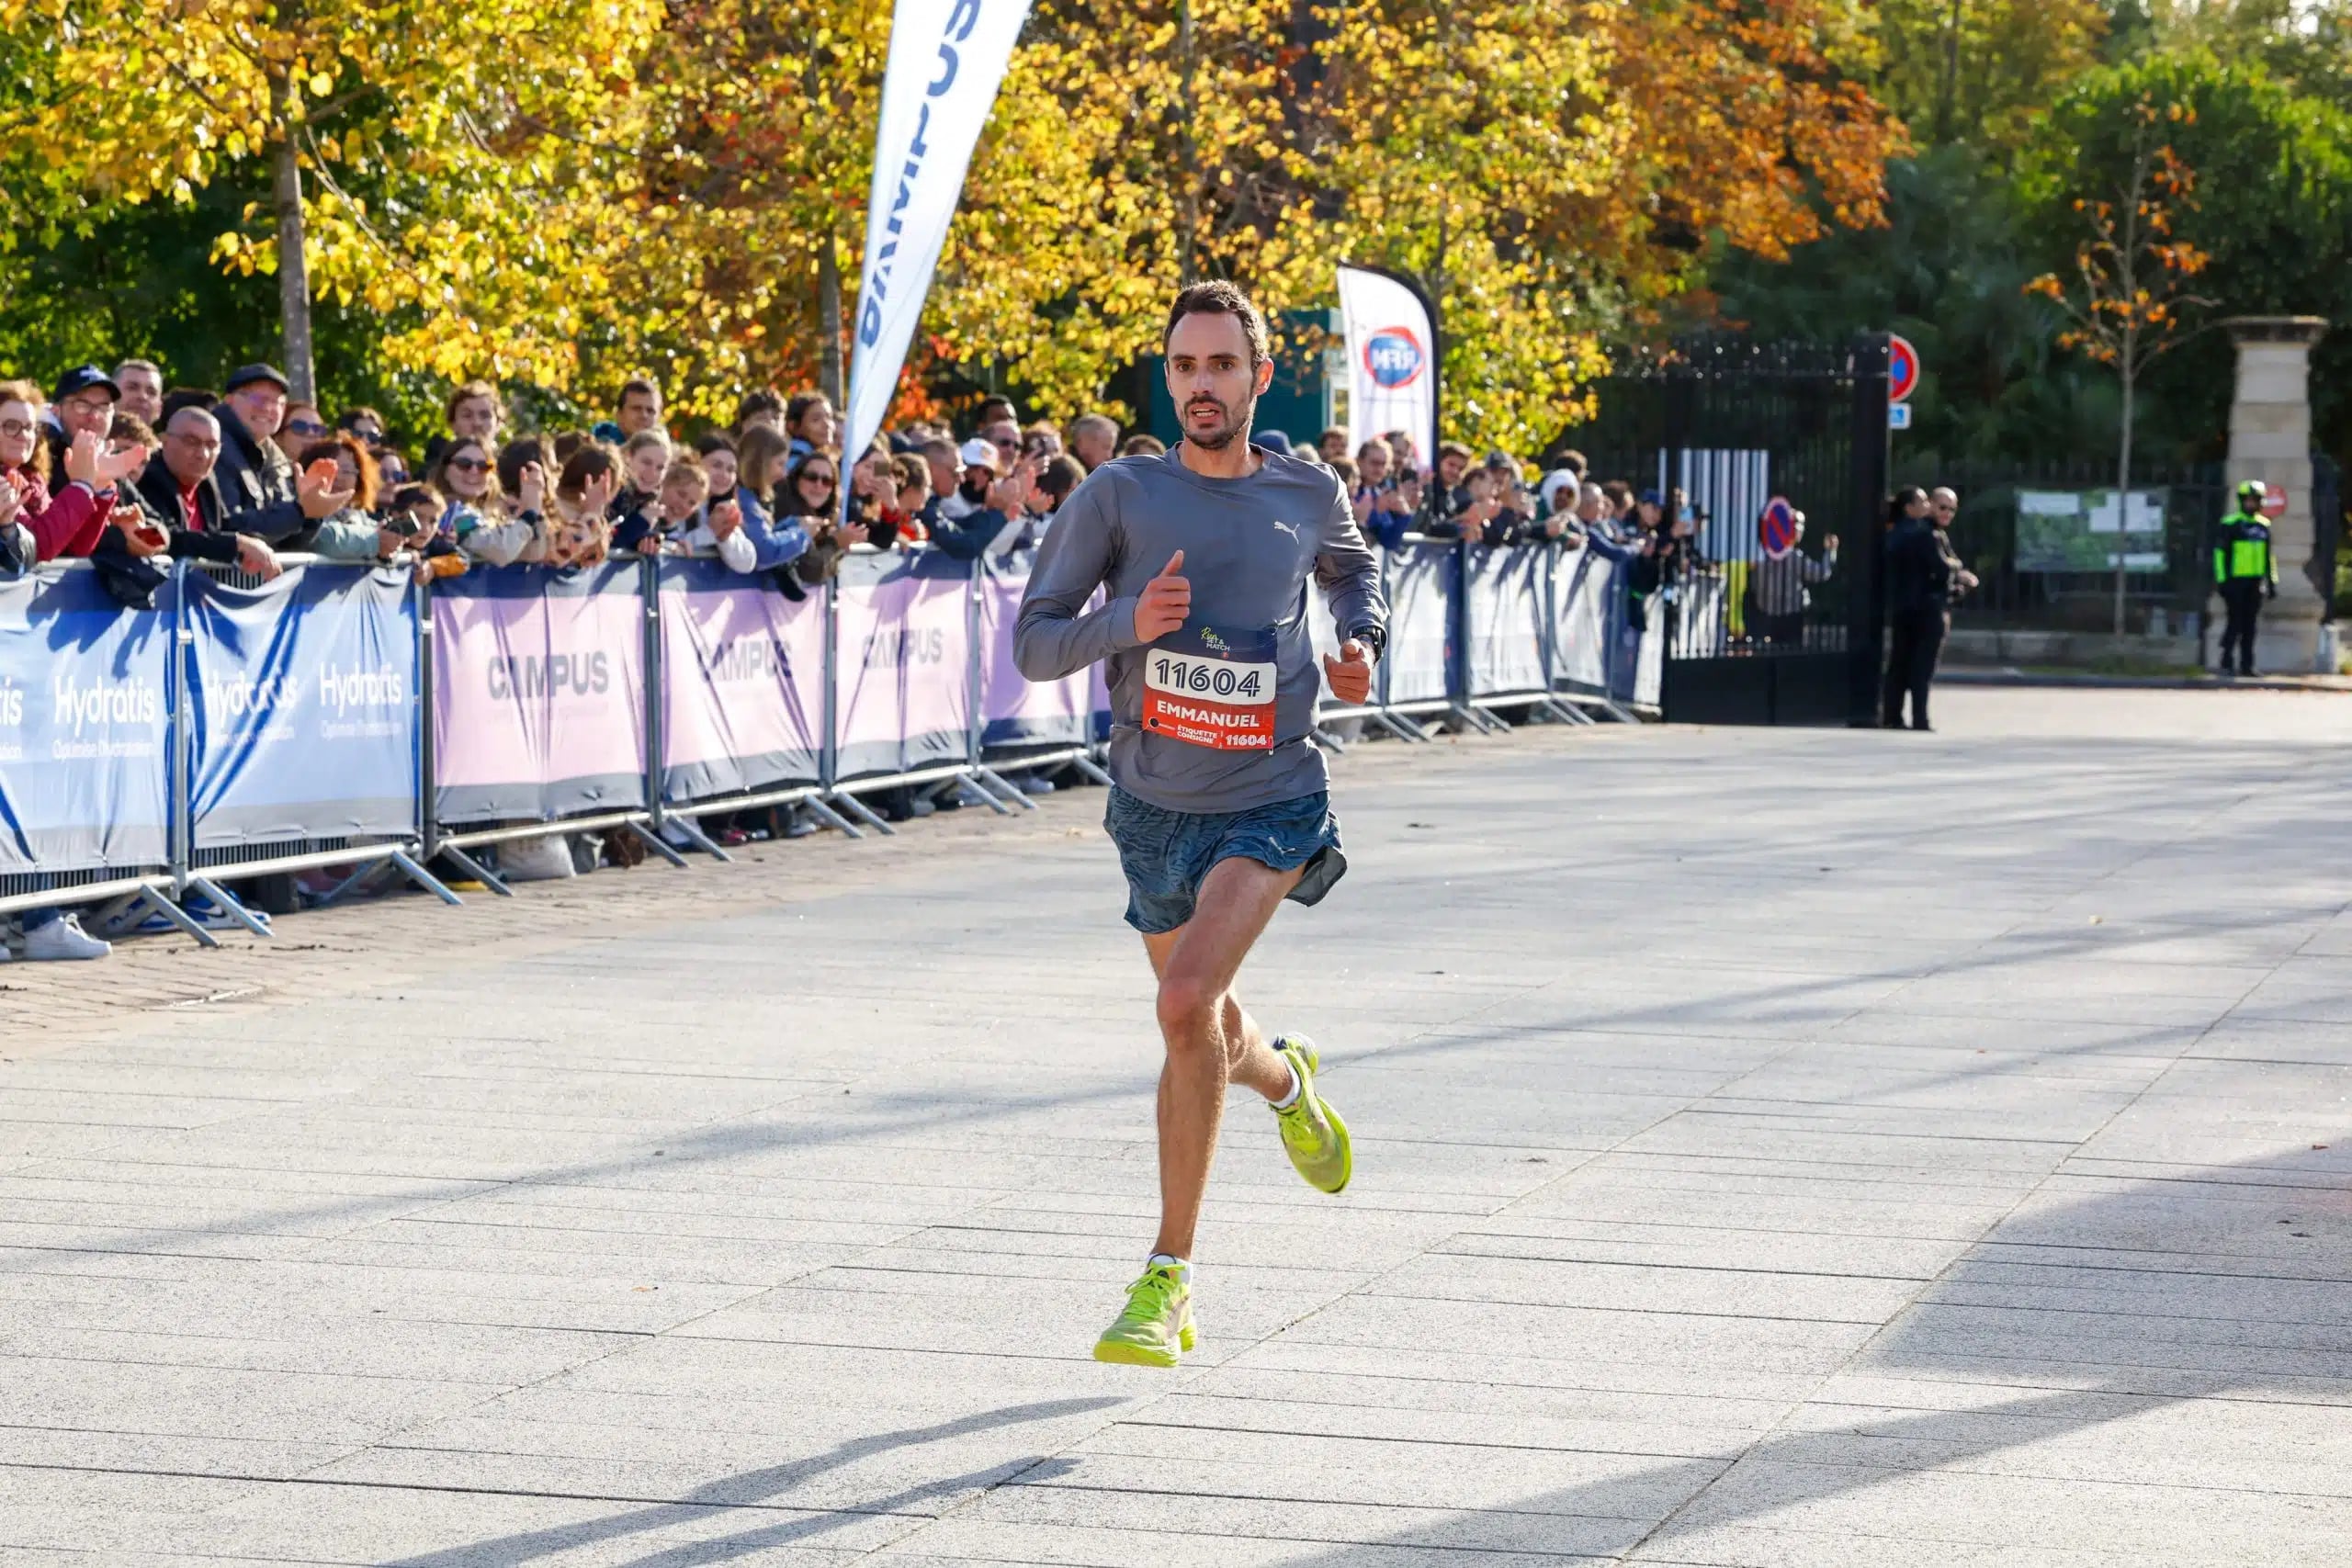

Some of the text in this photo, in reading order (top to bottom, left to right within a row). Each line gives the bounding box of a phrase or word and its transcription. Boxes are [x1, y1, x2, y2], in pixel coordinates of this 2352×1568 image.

[1201, 626, 1219, 640] Run
[1206, 643, 1230, 652] MATCH
[1155, 659, 1261, 698] 11604
[54, 676, 155, 738] Hydratis
[1158, 700, 1260, 728] EMMANUEL
[1177, 724, 1217, 739] ÉTIQUETTE
[1177, 730, 1215, 744] CONSIGNE
[1226, 734, 1268, 747] 11604
